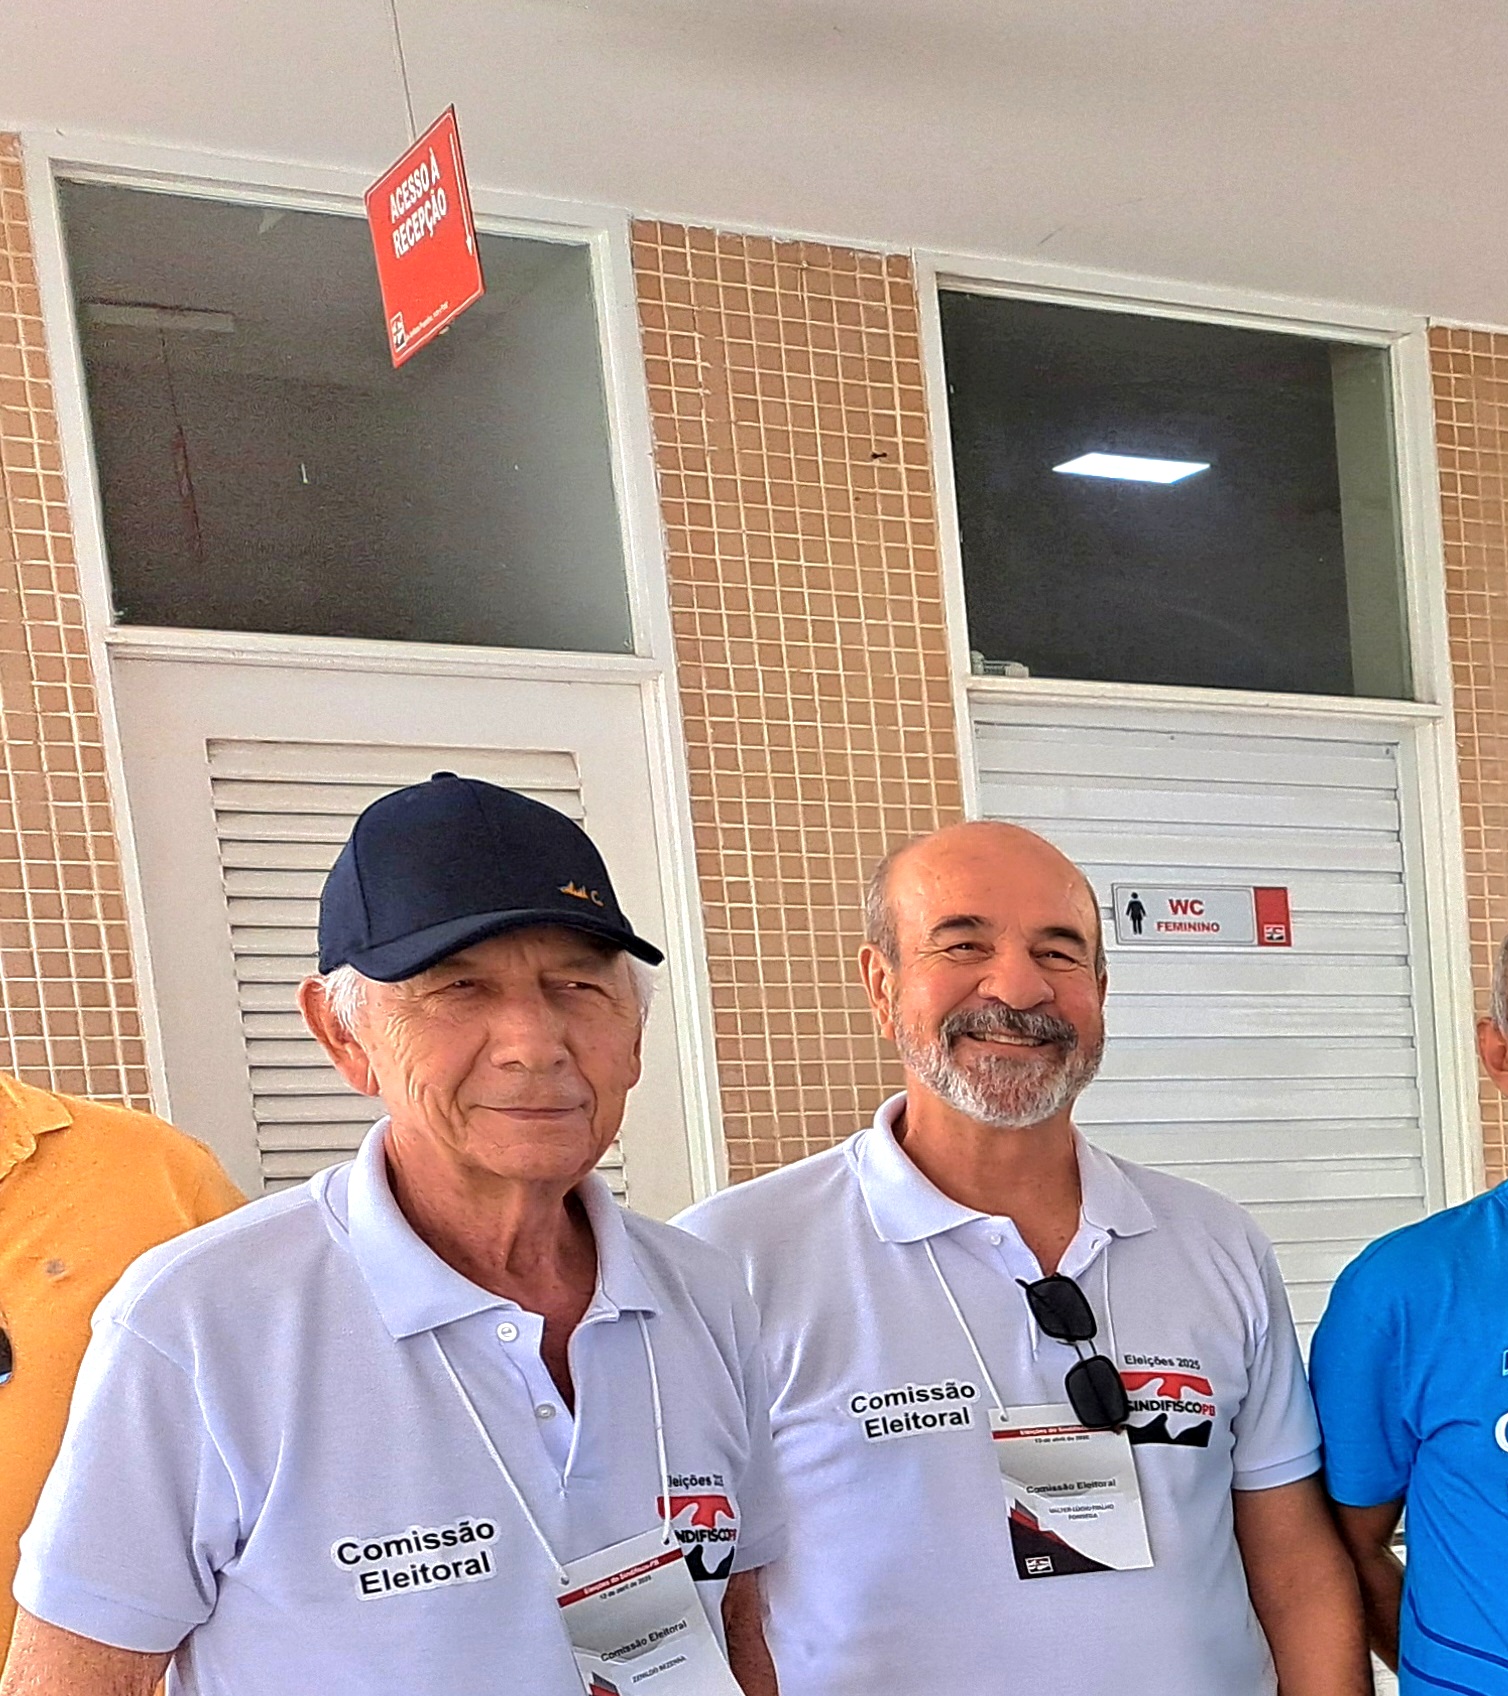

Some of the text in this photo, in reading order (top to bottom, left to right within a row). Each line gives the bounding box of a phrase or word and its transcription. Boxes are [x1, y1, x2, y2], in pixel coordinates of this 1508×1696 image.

[390, 146, 441, 224] ACESSO À
[392, 187, 447, 259] RECEPÇÃO
[1168, 898, 1205, 916] WC
[1156, 921, 1221, 933] FEMININO
[1124, 1354, 1201, 1370] Eleições 2025
[850, 1381, 976, 1413] Comissão
[864, 1406, 970, 1438] Eleitoral
[1026, 1478, 1116, 1495] Comissão Eleitoral
[337, 1520, 495, 1565] Comissão
[359, 1551, 490, 1594] Eleitoral
[600, 1619, 687, 1663] Comissão Eleitoral
